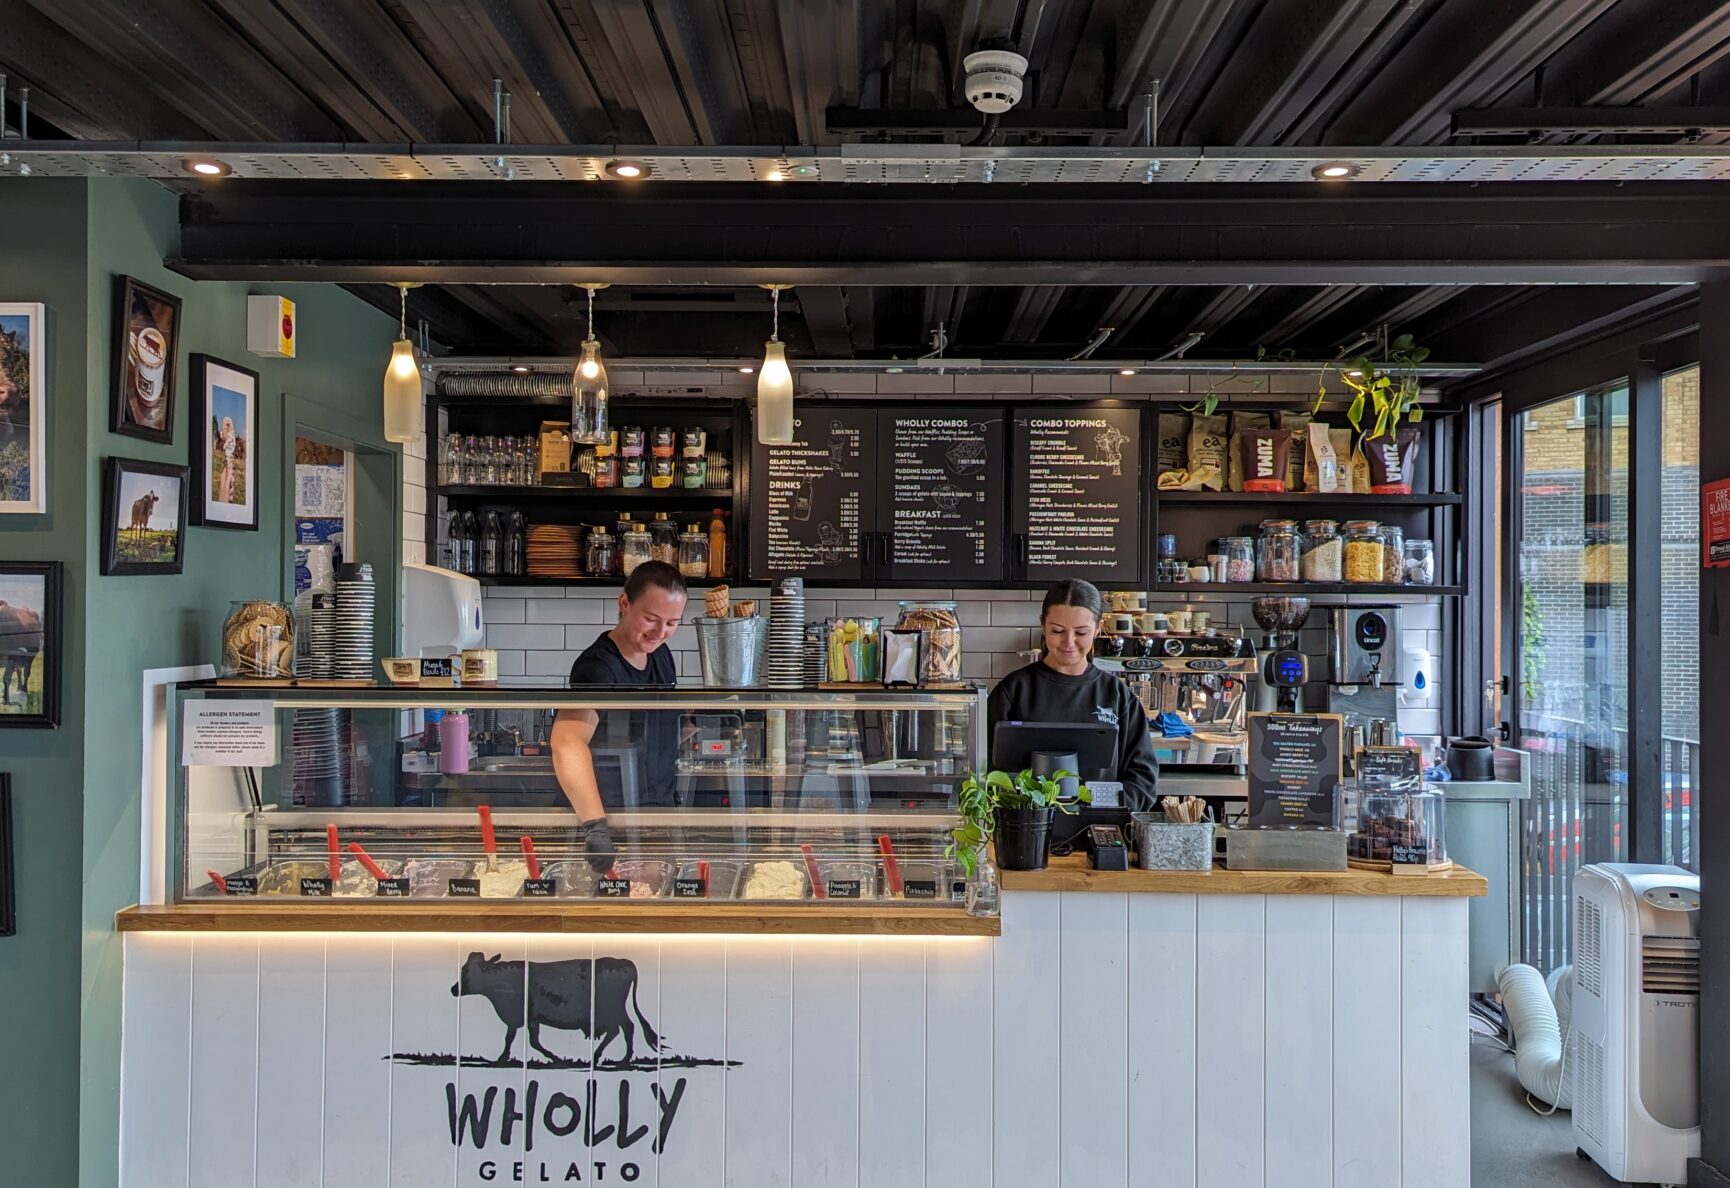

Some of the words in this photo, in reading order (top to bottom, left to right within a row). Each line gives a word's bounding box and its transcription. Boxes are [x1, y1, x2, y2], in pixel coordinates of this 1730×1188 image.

[895, 420, 930, 428] WHOLLY
[931, 420, 968, 428] COMBOS
[1031, 420, 1063, 428] COMBO
[1064, 420, 1107, 428] TOPPINGS
[1162, 437, 1180, 448] ea
[1203, 437, 1221, 448] ea
[1257, 438, 1274, 477] ZUMA
[1382, 444, 1402, 483] ZUMA
[1716, 490, 1729, 503] FIRE
[1287, 723, 1323, 735] Takeaways
[302, 880, 326, 892] Wholly
[451, 884, 478, 894] Banana
[600, 881, 615, 889] White
[616, 881, 628, 889] Choc
[830, 883, 852, 891] Pineapple
[906, 885, 934, 895] Pistachio
[308, 888, 322, 896] Milk
[446, 1078, 687, 1155] WHOLLY
[479, 1161, 641, 1182] GELATO
